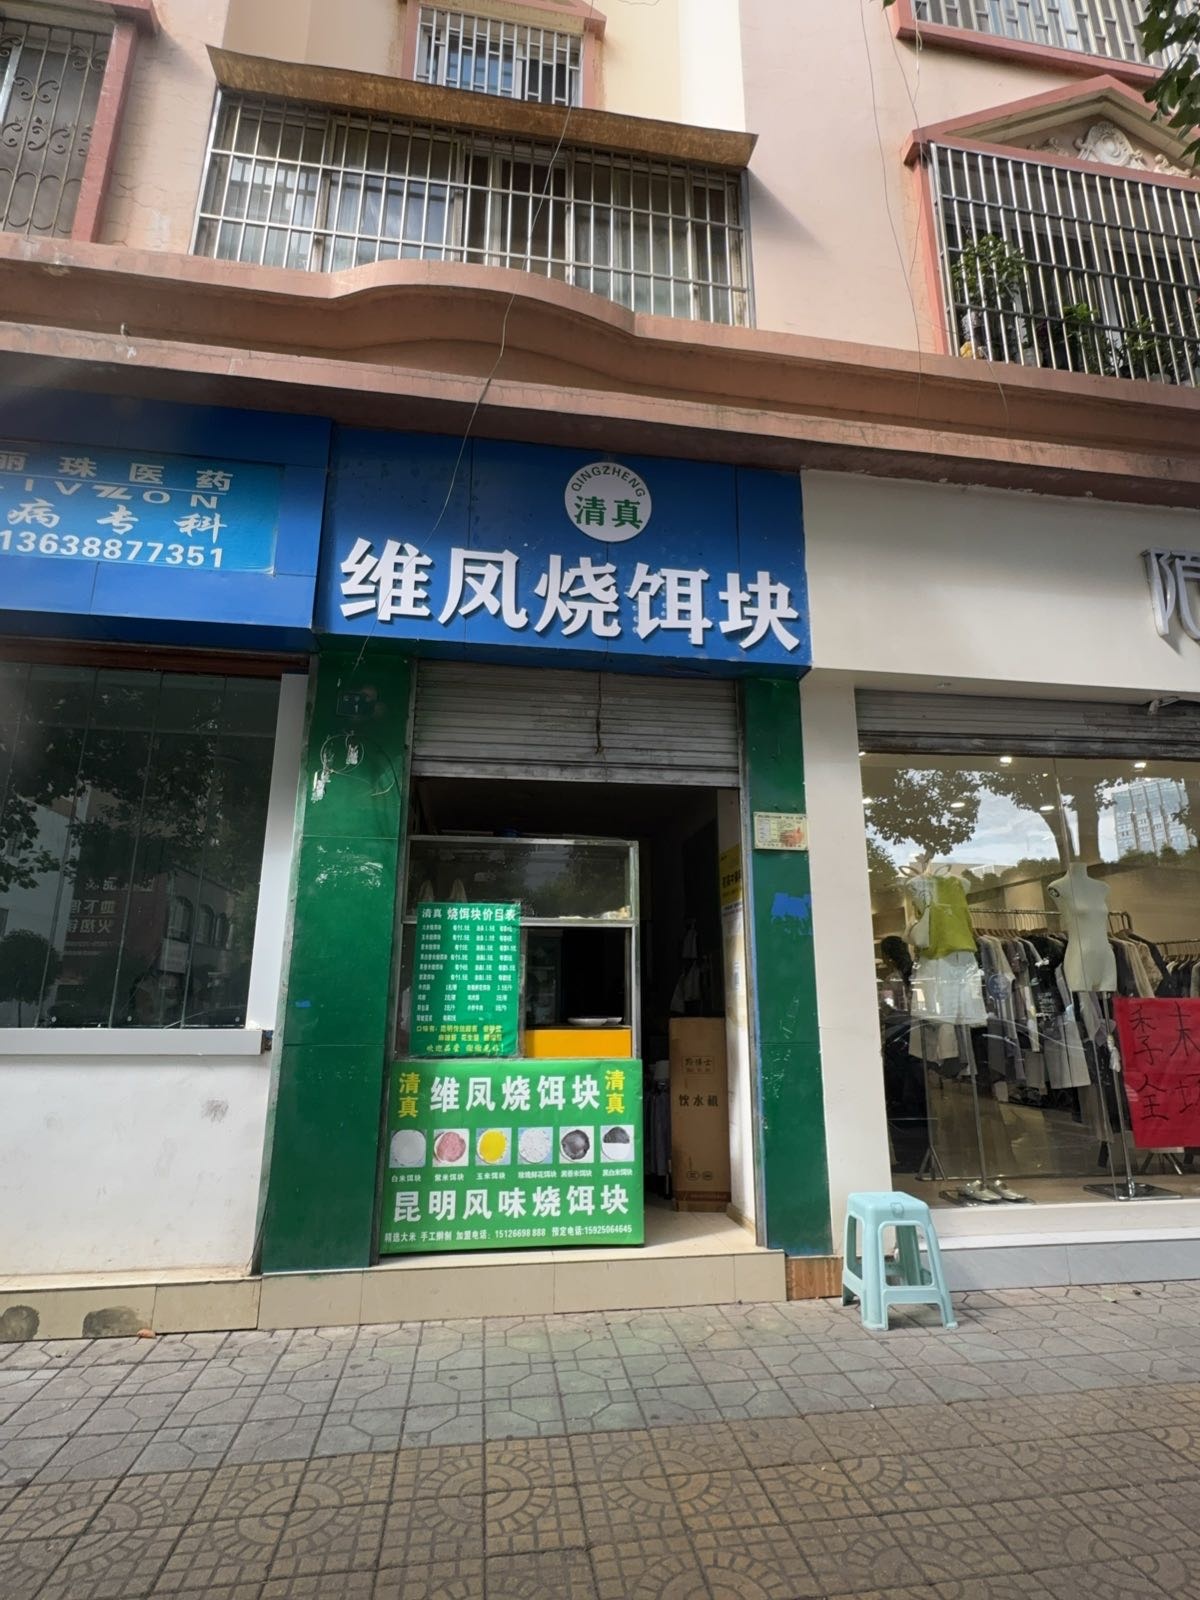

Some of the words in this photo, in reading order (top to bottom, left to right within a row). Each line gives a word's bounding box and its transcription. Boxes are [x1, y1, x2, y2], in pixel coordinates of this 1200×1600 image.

[0, 478, 217, 509] IVZON
[571, 465, 646, 498] QINGZHENG
[7, 497, 227, 544] 病专科
[574, 496, 643, 530] 清真
[0, 530, 223, 568] 13638877351
[339, 537, 800, 652] 维凤烧饵块
[422, 908, 442, 919] 清真
[447, 907, 516, 921] 烧饵块价目表
[398, 1072, 420, 1118] 清真
[430, 1075, 600, 1113] 维凤烧饵块
[605, 1070, 626, 1115] 清真
[391, 1174, 421, 1183] 白米饵块
[434, 1173, 464, 1181] 紫米饵块
[476, 1172, 506, 1180] 玉米饵块
[394, 1184, 629, 1222] 昆明风味烧饵块
